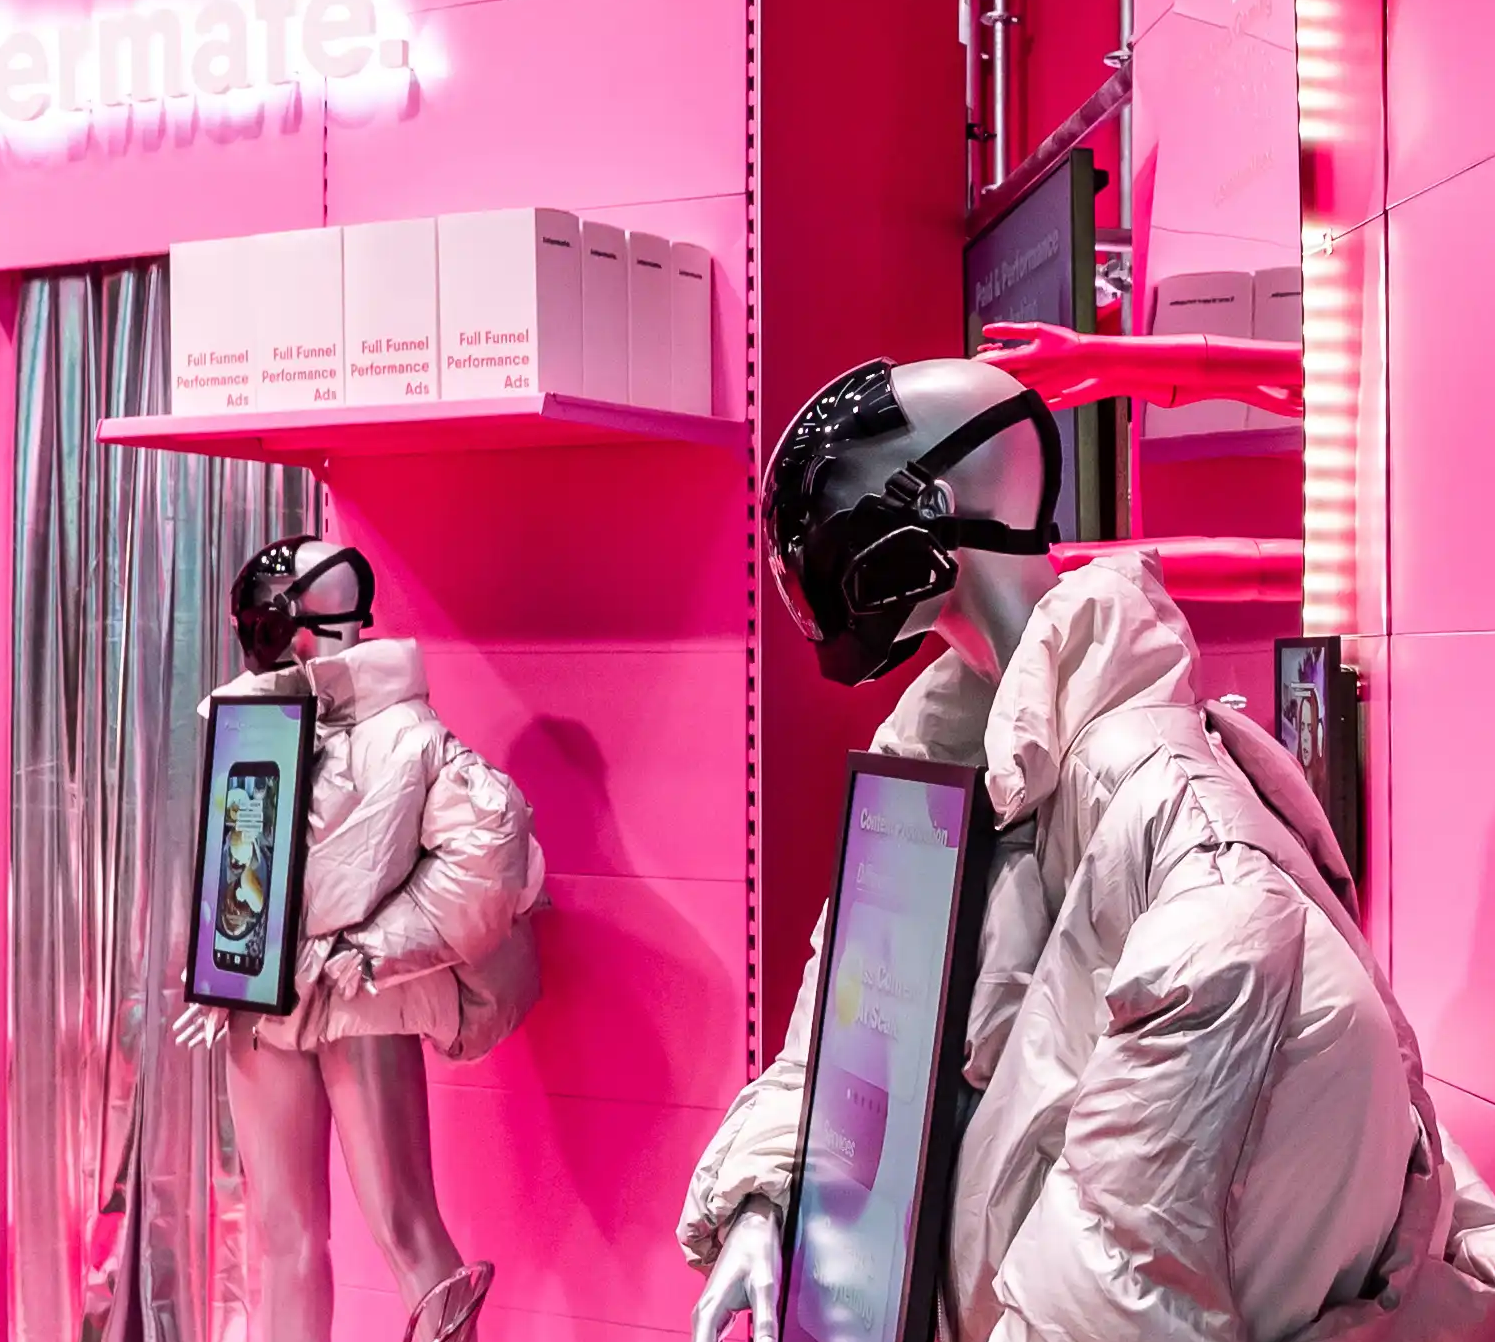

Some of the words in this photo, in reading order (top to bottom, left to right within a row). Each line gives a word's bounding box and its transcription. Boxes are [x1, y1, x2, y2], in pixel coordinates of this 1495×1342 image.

[460, 331, 481, 346] Full
[485, 328, 529, 344] Funnel
[273, 346, 293, 361] Full
[297, 343, 336, 359] Funnel
[361, 339, 382, 355] Full
[386, 336, 429, 353] Funnel
[187, 353, 206, 368] Full
[210, 350, 249, 365] Funnel
[447, 354, 530, 370] Performance
[262, 368, 337, 384] Performance
[350, 361, 430, 377] Performance
[176, 374, 249, 390] Performance
[405, 381, 430, 396] Ads
[504, 374, 530, 389] Ads
[226, 392, 249, 408] Ads
[314, 388, 337, 402] Ads
